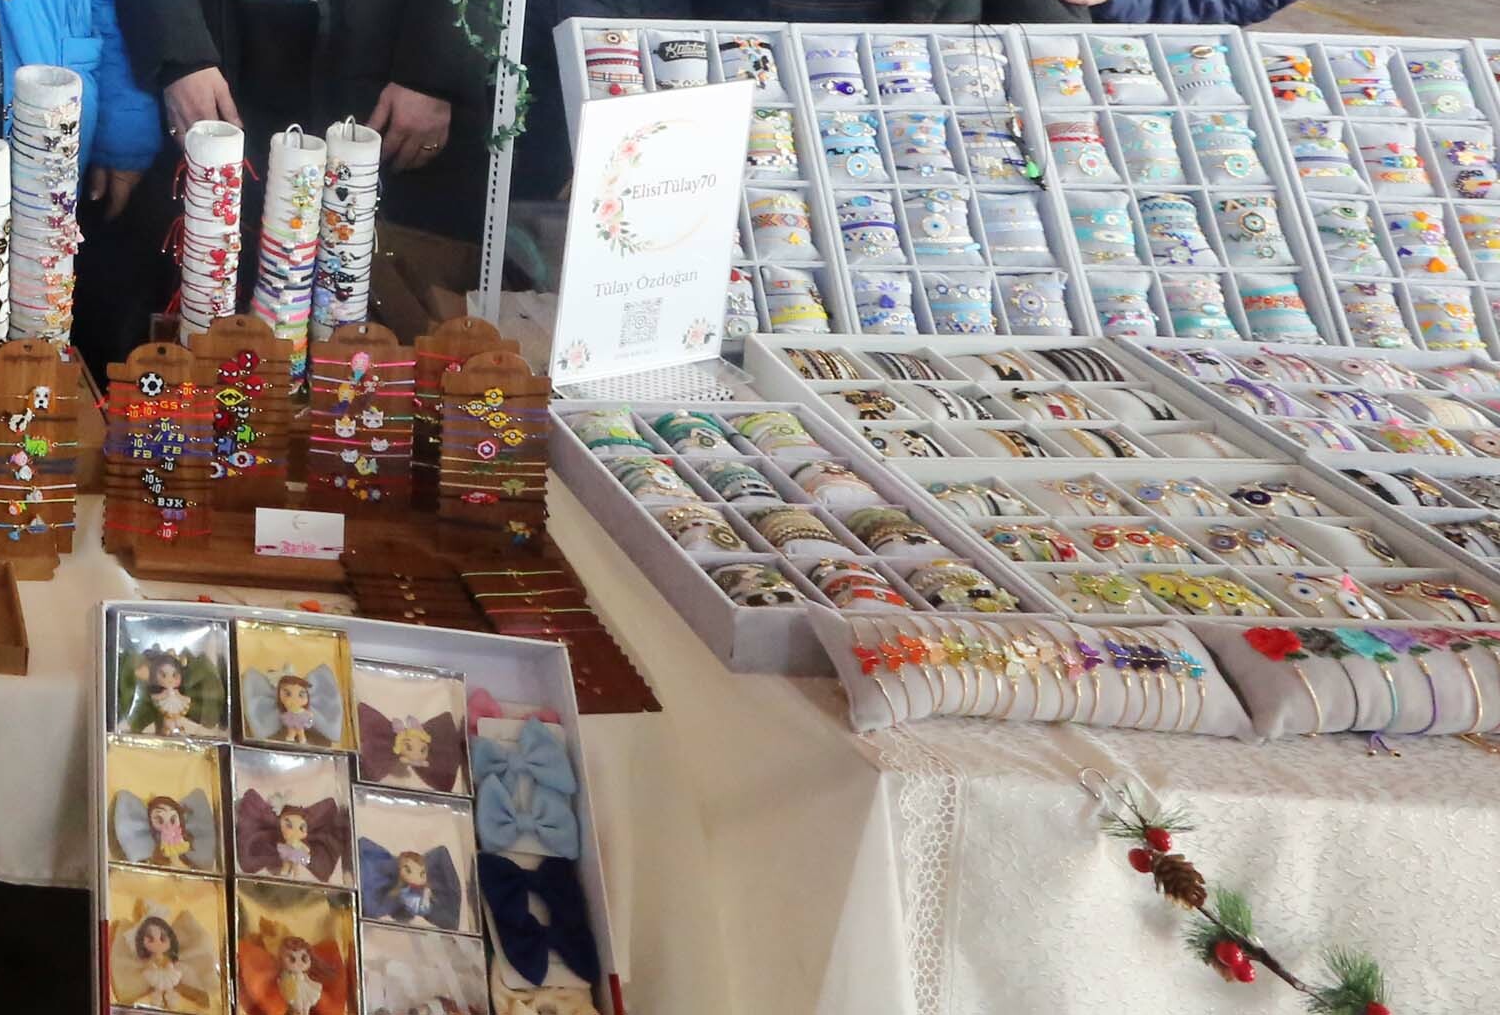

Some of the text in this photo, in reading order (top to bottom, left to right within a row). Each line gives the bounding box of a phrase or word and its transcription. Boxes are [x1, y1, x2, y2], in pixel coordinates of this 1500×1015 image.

[593, 268, 699, 298] Tülay Özdoğan
[159, 400, 178, 410] GS
[167, 432, 186, 442] FB
[133, 449, 152, 459] FB
[162, 445, 182, 455] FB
[157, 497, 184, 508] BJK
